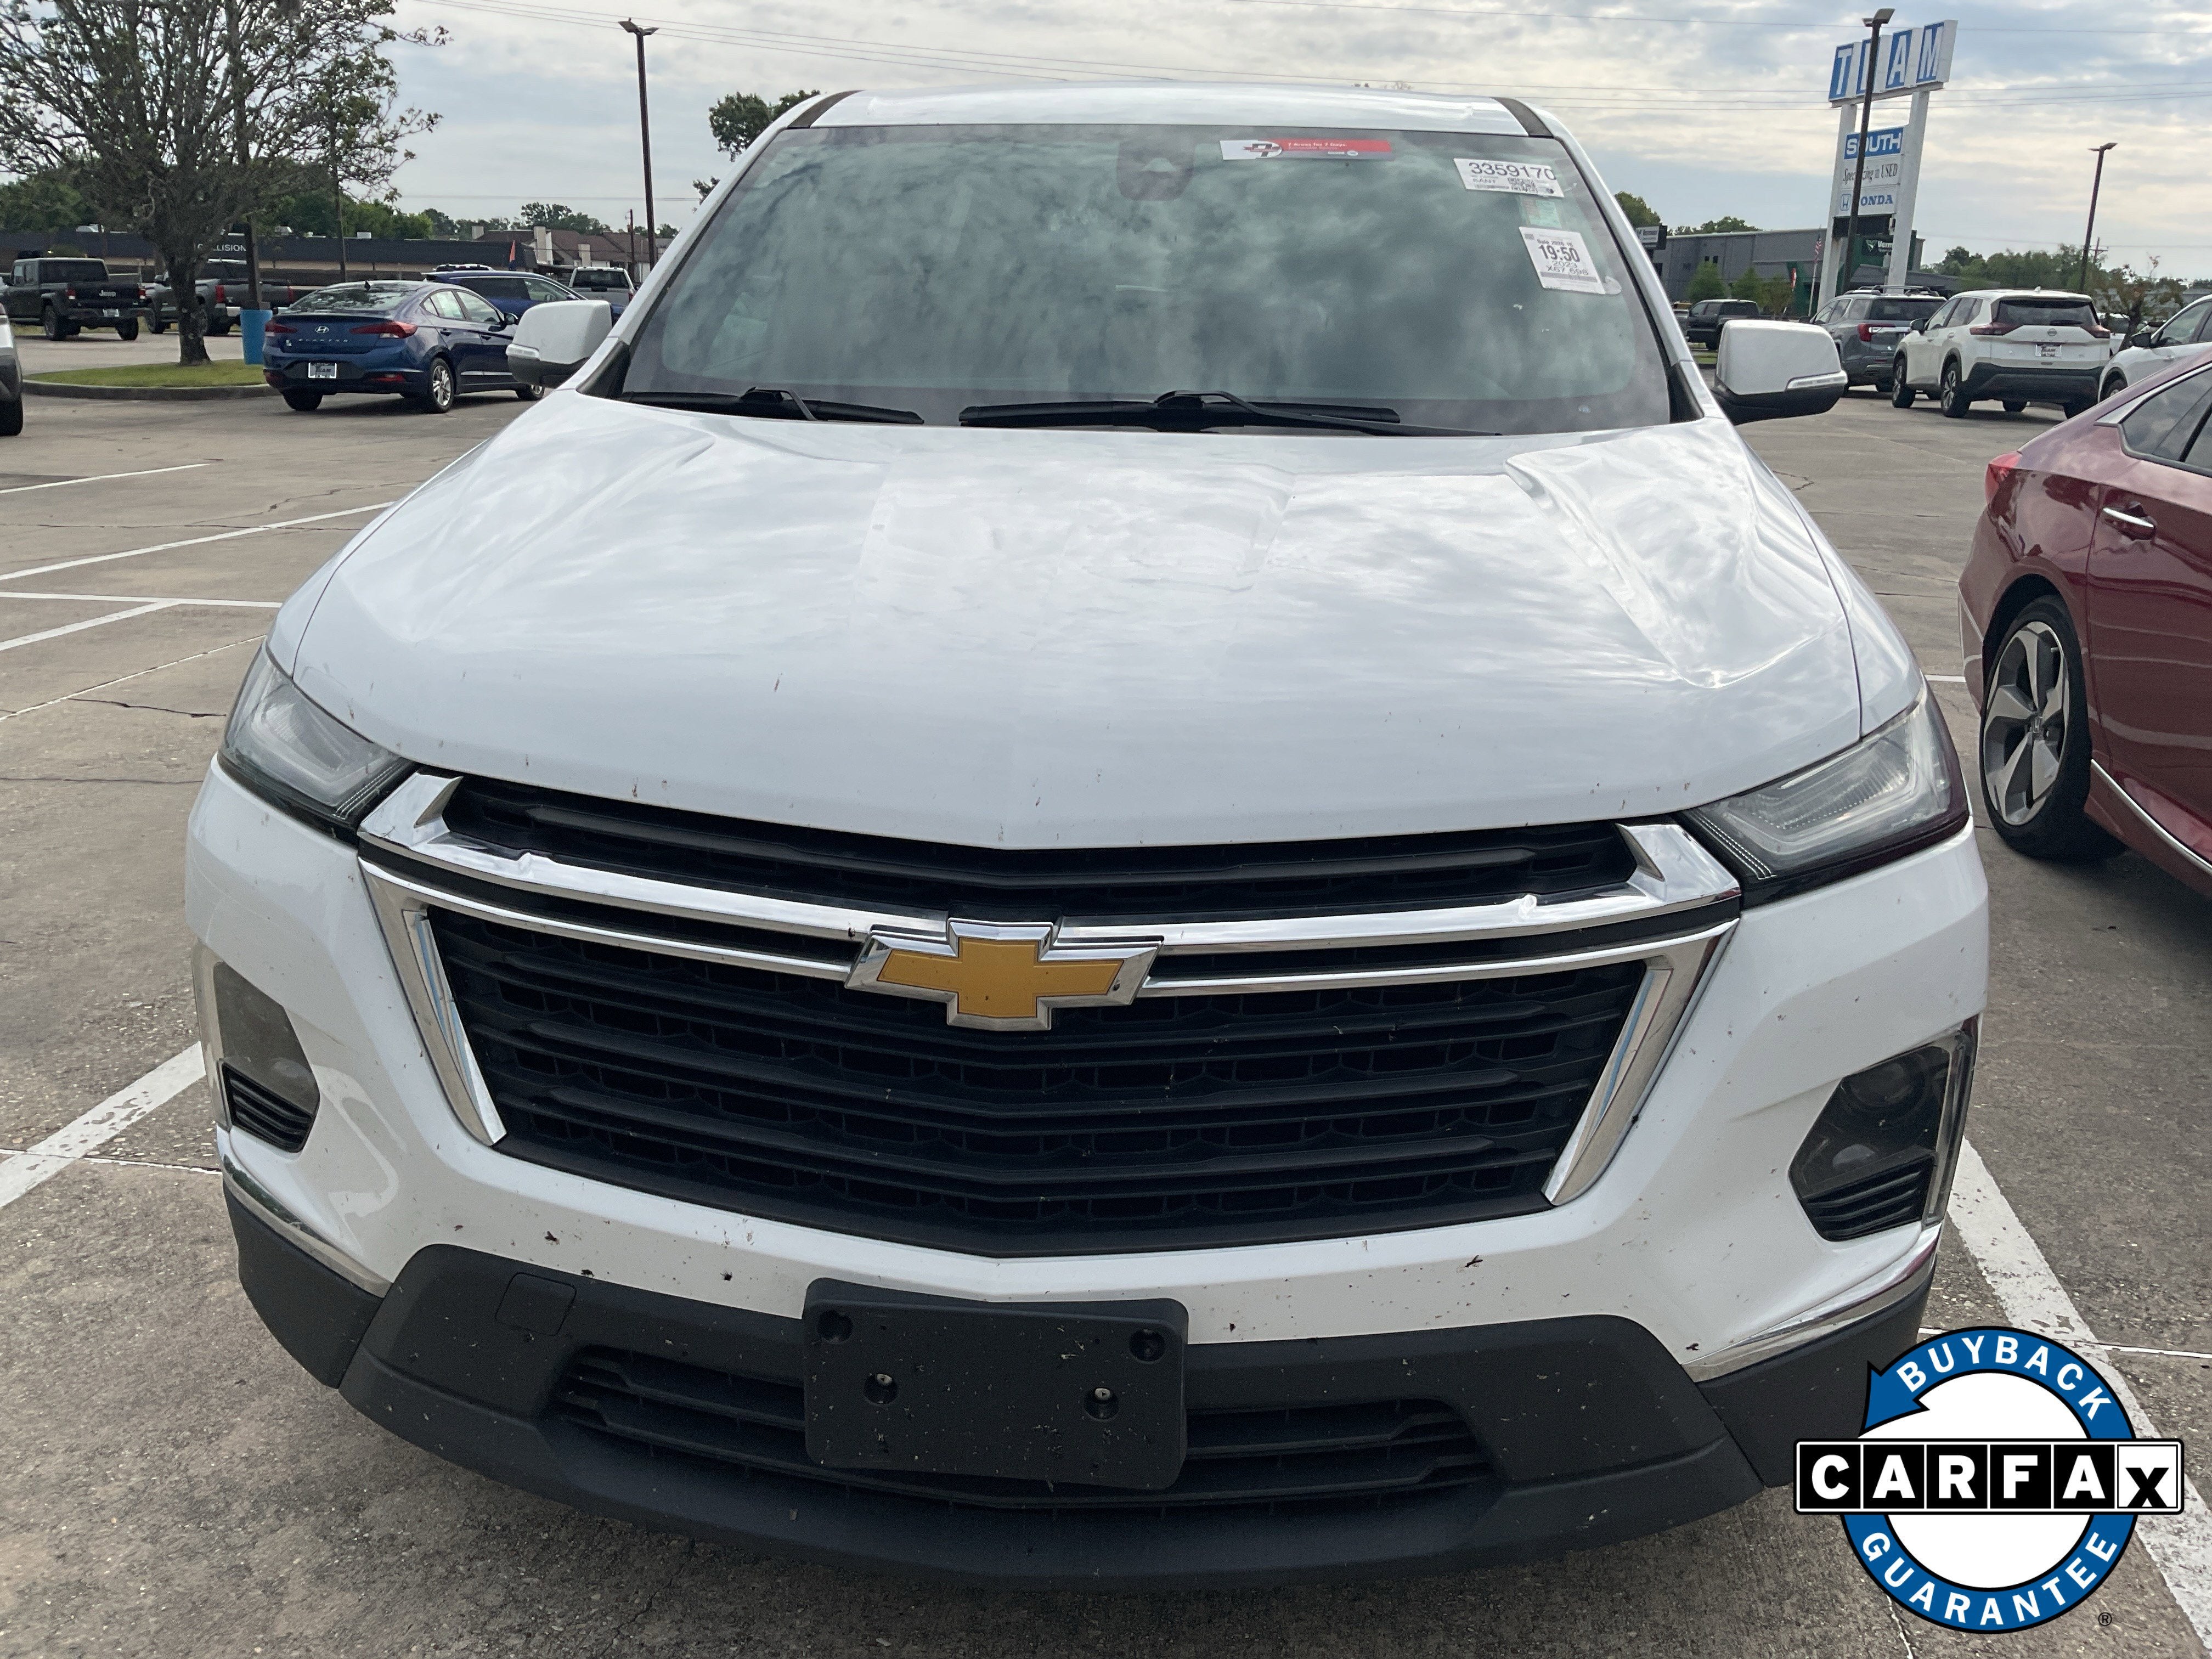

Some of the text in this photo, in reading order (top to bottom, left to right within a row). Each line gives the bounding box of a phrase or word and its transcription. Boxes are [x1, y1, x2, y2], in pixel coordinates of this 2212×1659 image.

[1846, 132, 1902, 155] SUTH
[1469, 162, 1556, 180] 3359170
[1881, 163, 1898, 178] USED
[1860, 195, 1893, 206] ONDA
[1538, 245, 1581, 263] 19:50
